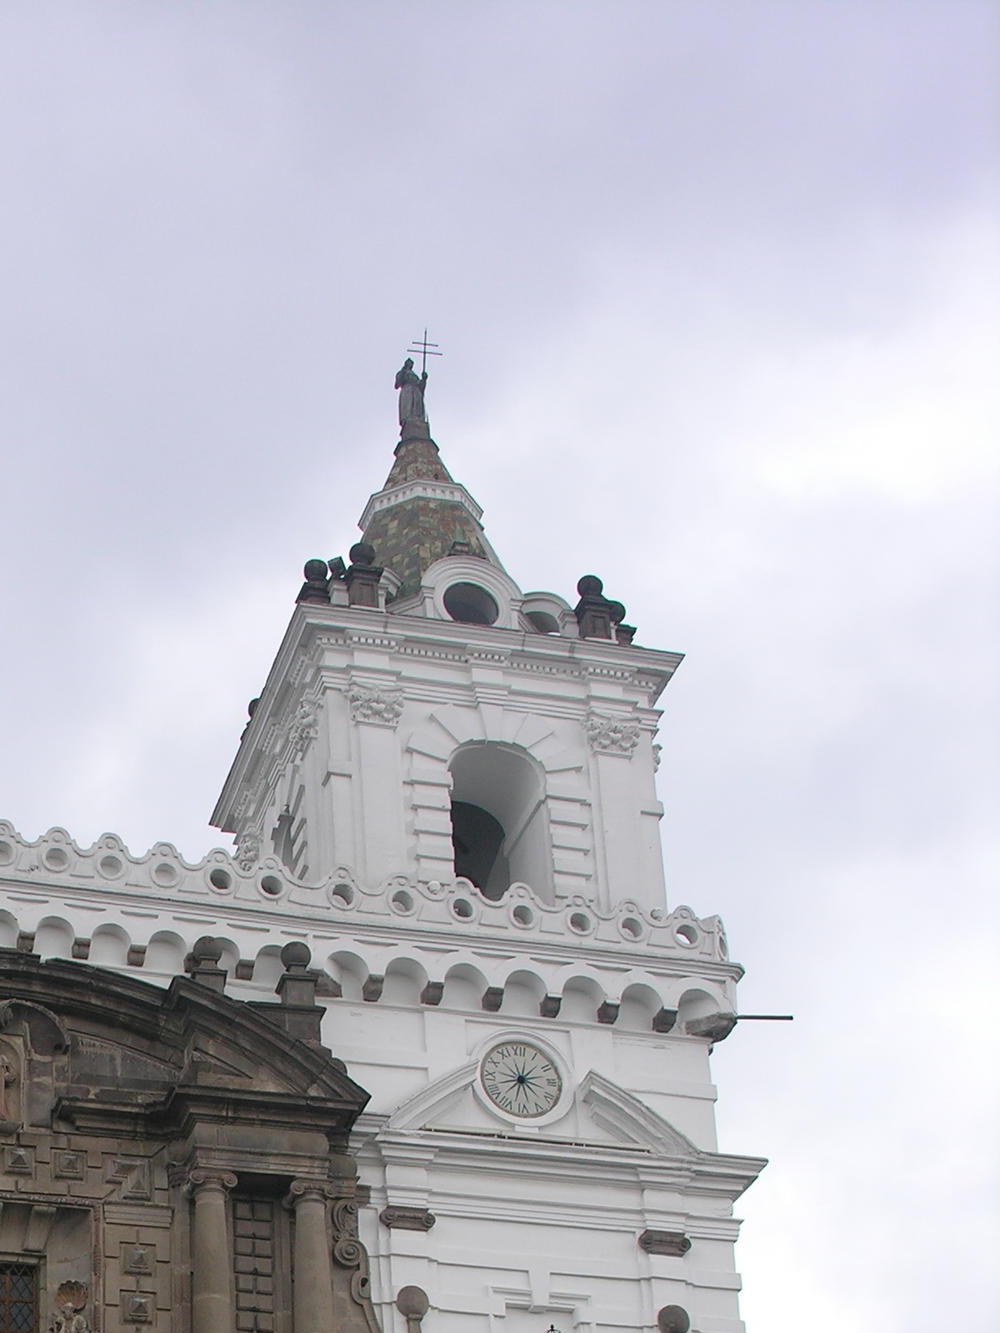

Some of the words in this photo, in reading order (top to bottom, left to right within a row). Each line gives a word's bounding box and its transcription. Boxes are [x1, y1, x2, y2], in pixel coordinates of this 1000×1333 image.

[496, 1048, 511, 1060] XI
[512, 1046, 526, 1056] XII
[488, 1057, 500, 1068] X
[484, 1069, 496, 1081] IX
[500, 1096, 512, 1110] VII
[518, 1102, 529, 1114] VI
